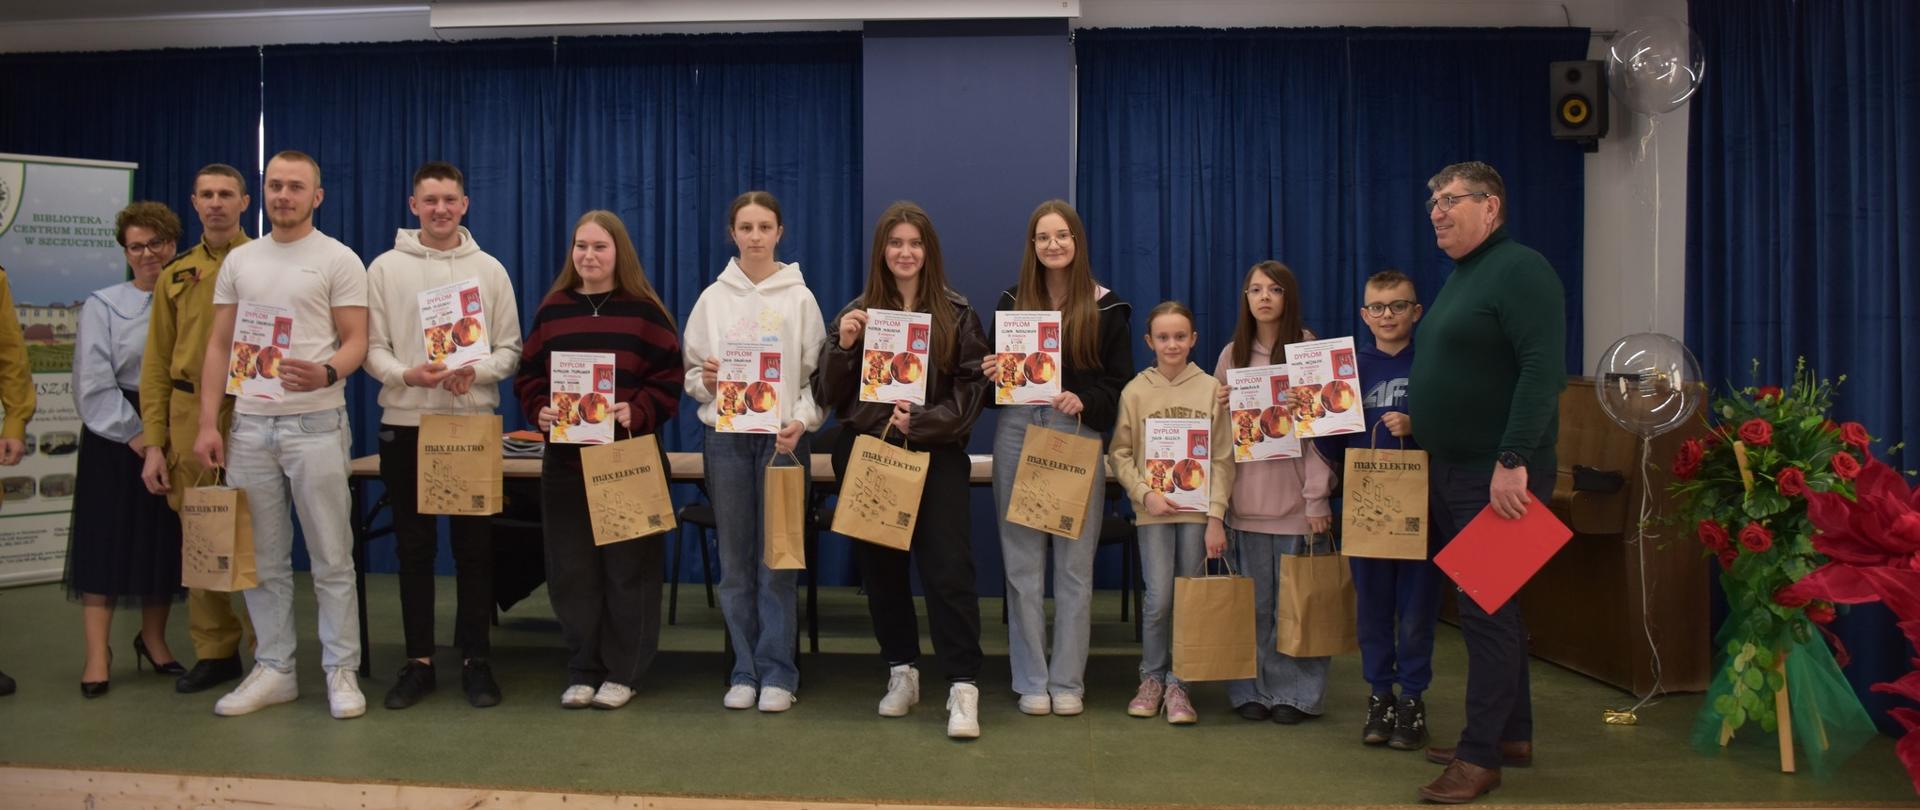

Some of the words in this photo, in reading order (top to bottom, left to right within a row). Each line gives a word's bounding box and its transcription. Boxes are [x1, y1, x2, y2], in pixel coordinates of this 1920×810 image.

[33, 213, 102, 225] BIBLIOTEKA
[13, 224, 71, 234] CENTRUM
[25, 237, 34, 246] W
[38, 238, 115, 248] SZCZUCZYNIE
[874, 319, 901, 327] DYPLOM
[1294, 351, 1322, 360] DYPLOM
[1235, 377, 1263, 385] DYPLOM
[446, 444, 484, 452] ELEKTRO
[862, 450, 883, 462] max
[883, 458, 921, 473] ELEKTRO
[1026, 455, 1049, 467] max
[1049, 460, 1086, 475] ELEKTRO
[1353, 461, 1378, 470] max
[1379, 462, 1421, 471] ELEKTRO
[615, 465, 651, 479] ELEKTRO
